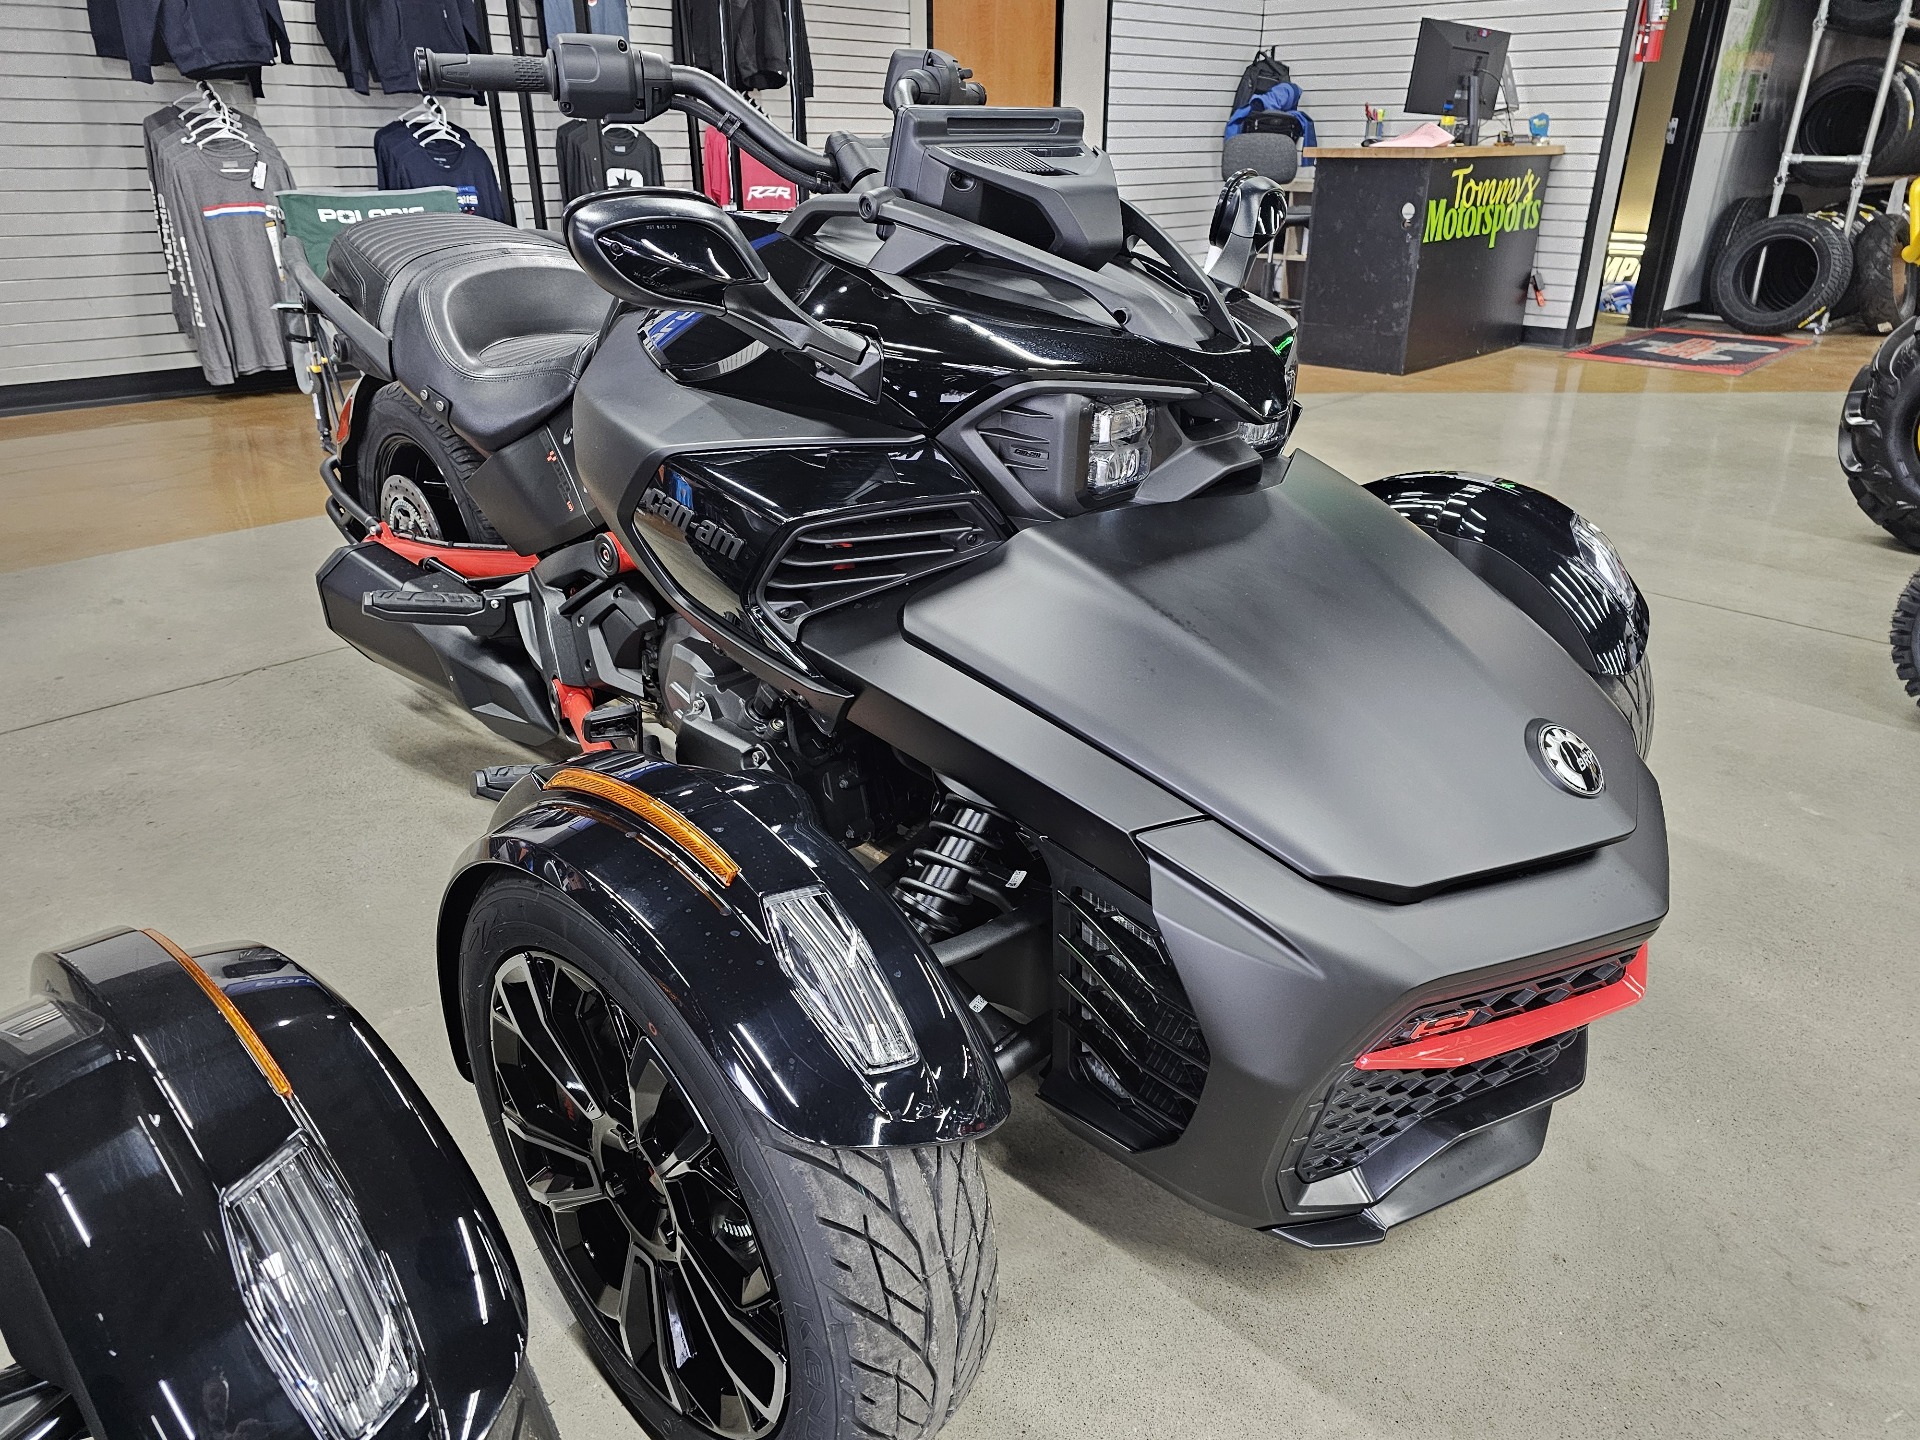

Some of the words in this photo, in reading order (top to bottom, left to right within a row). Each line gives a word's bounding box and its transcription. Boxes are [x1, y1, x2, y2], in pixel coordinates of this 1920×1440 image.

[747, 185, 791, 202] RZR
[1452, 164, 1541, 212] Tommy's
[1422, 198, 1542, 249] Motorsports
